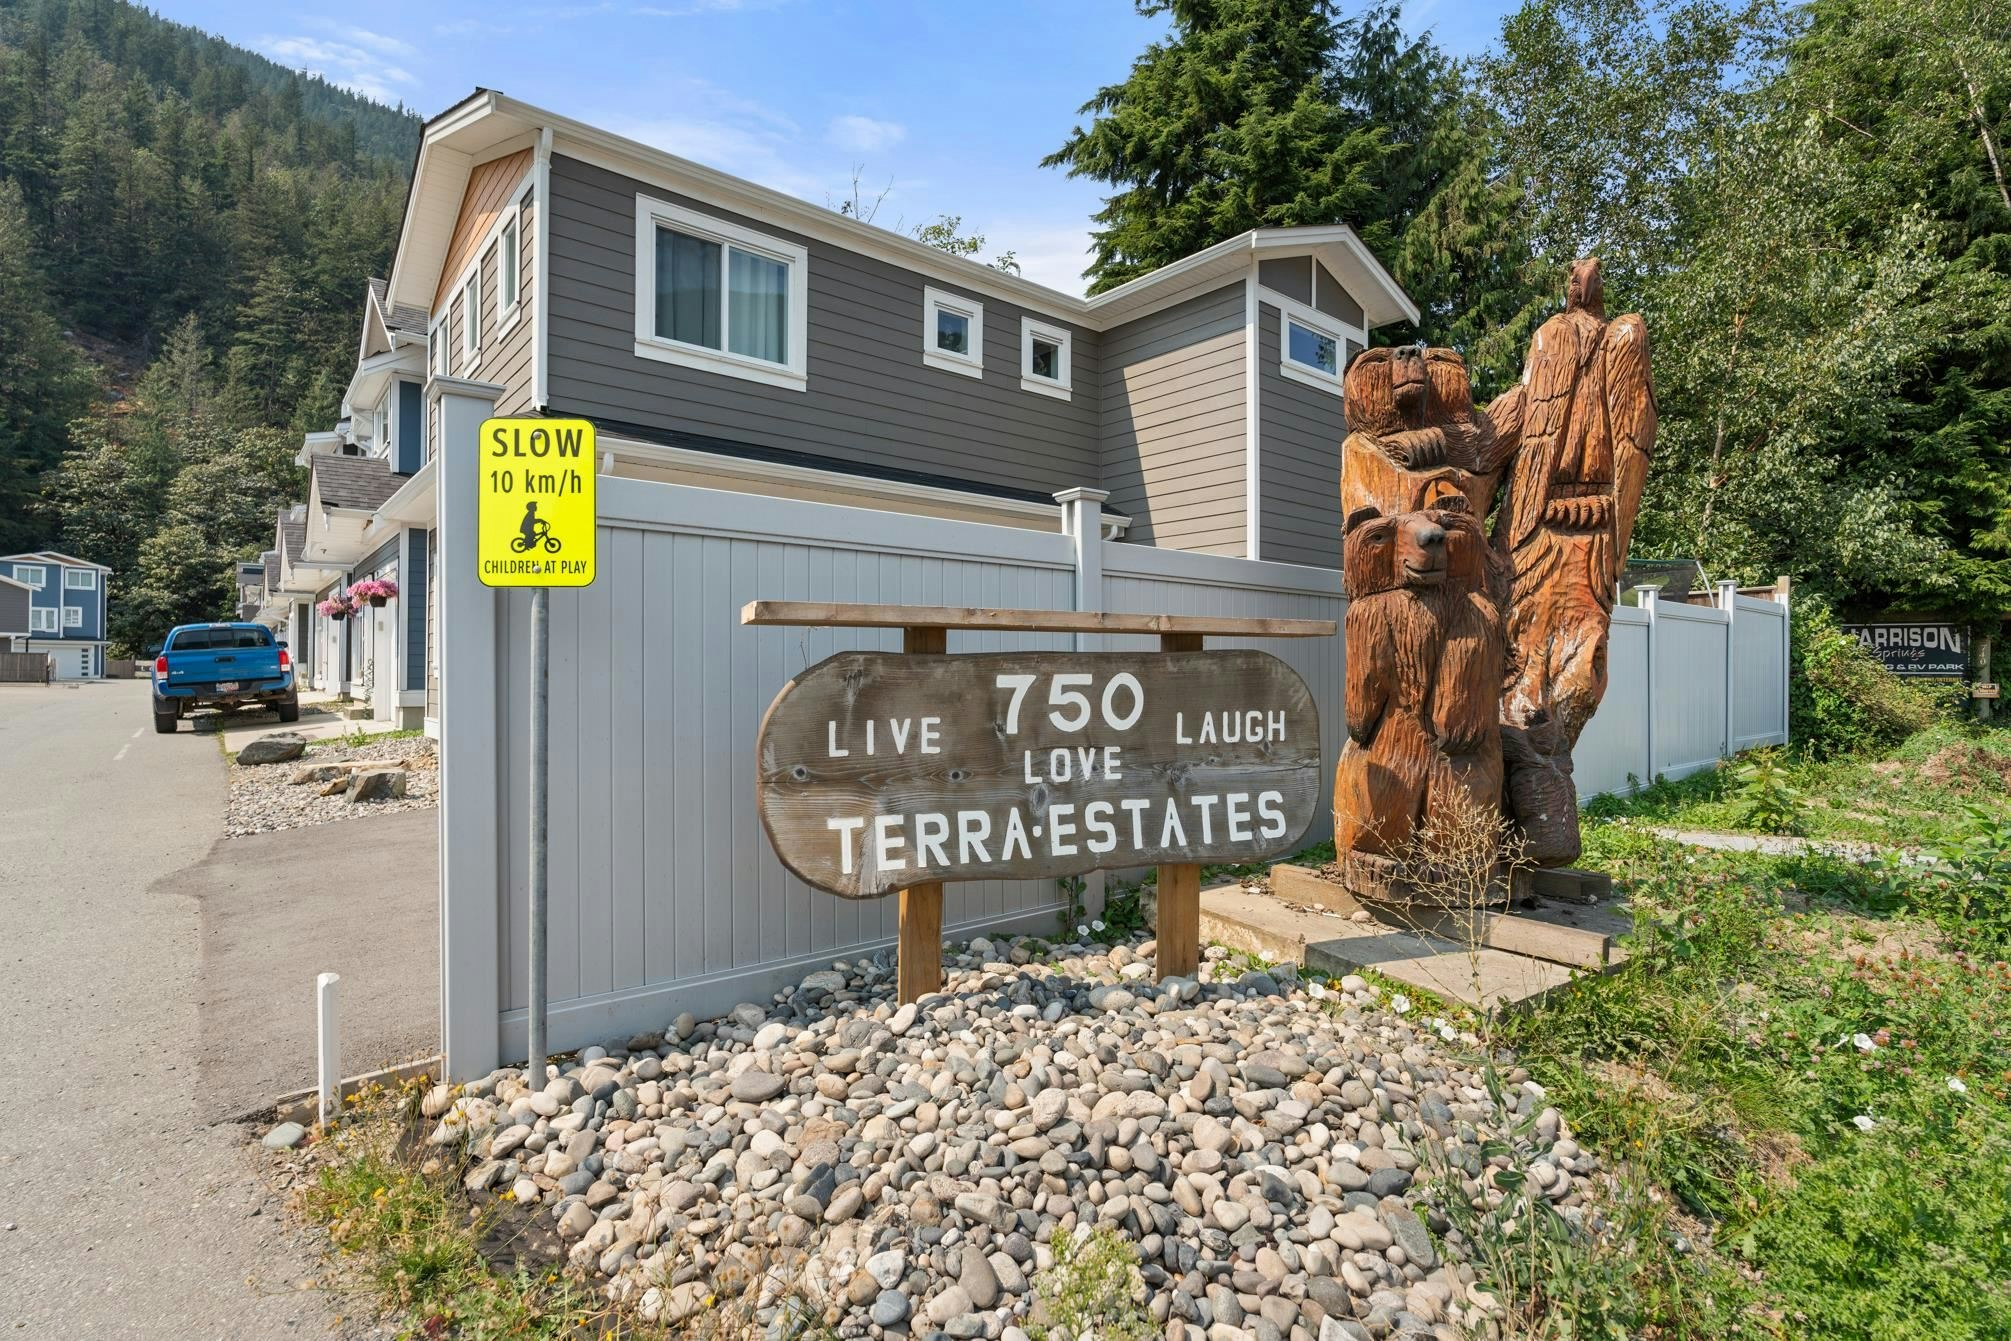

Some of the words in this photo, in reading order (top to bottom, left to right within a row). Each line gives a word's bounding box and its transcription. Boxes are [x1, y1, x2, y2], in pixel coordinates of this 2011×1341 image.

[492, 428, 583, 457] SLOW
[491, 470, 513, 494] 10
[525, 469, 582, 497] km/h
[544, 560, 556, 573] AT
[561, 560, 587, 574] PLAY
[1847, 627, 1961, 653] ARRISON
[1929, 663, 1965, 671] PARK
[996, 672, 1145, 735] 750
[828, 717, 942, 758] LIVE
[1176, 710, 1286, 745] LAUGH
[1024, 746, 1123, 784] LOVE
[1048, 790, 1287, 857] ESTATES
